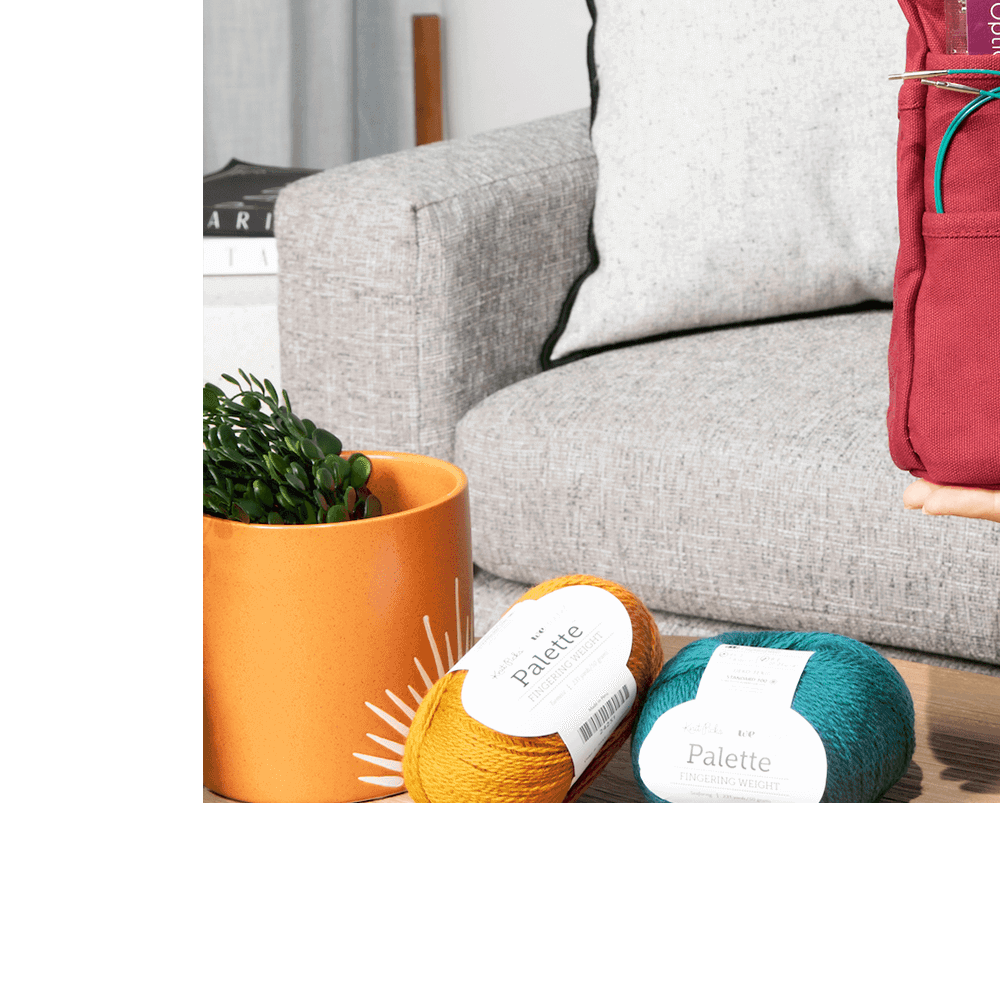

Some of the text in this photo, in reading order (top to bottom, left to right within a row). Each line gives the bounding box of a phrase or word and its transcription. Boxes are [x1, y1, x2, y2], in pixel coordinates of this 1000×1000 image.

[510, 625, 584, 688] Palette
[527, 630, 604, 703] FINGERING WEIGHT
[680, 771, 780, 791] FINGERING WEIGHT
[686, 743, 772, 773] Palette
